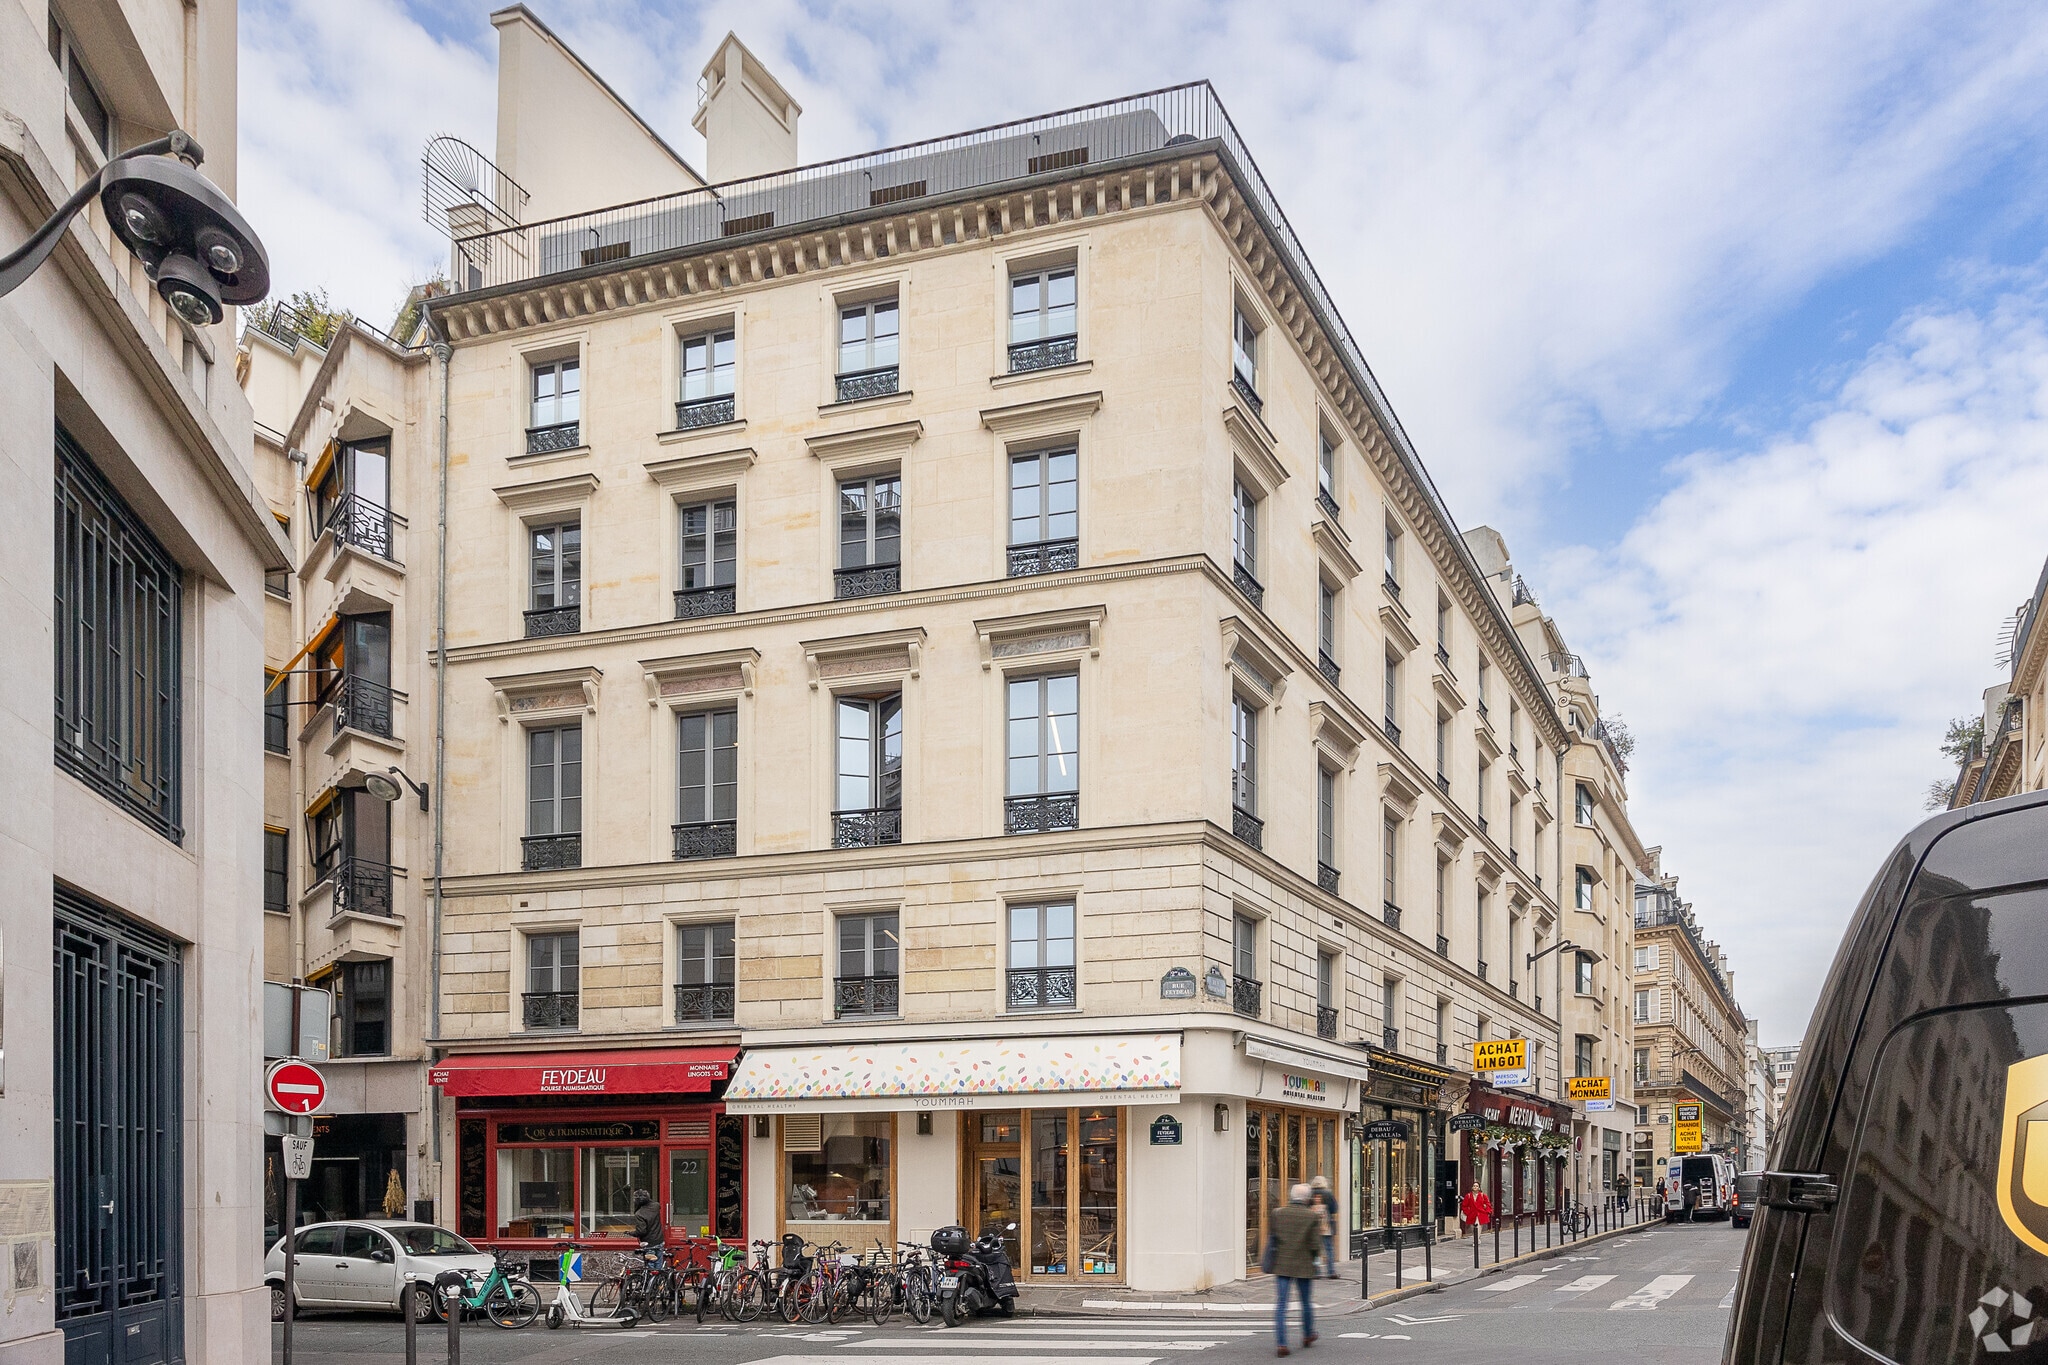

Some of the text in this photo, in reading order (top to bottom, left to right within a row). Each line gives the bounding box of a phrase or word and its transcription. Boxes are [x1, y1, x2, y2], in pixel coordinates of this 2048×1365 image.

[1479, 1042, 1519, 1055] ACHAT
[1476, 1055, 1522, 1068] LINGOT
[541, 1068, 606, 1085] FEYDEAU
[1283, 1073, 1326, 1093] YOUMMAH
[1575, 1079, 1604, 1088] ACHAT
[1570, 1089, 1608, 1098] MONNAIE
[301, 1098, 310, 1112] 1
[914, 1097, 974, 1107] YOUMMAH
[1484, 1107, 1501, 1121] ACHAT
[1508, 1105, 1535, 1127] MERSON
[533, 1128, 547, 1137] OR
[556, 1127, 624, 1137] NUMISMATIQUE
[1559, 1118, 1570, 1135] VENTE
[292, 1139, 308, 1151] SAUF
[681, 1161, 698, 1174] 22
[480, 1279, 493, 1297] TIER
